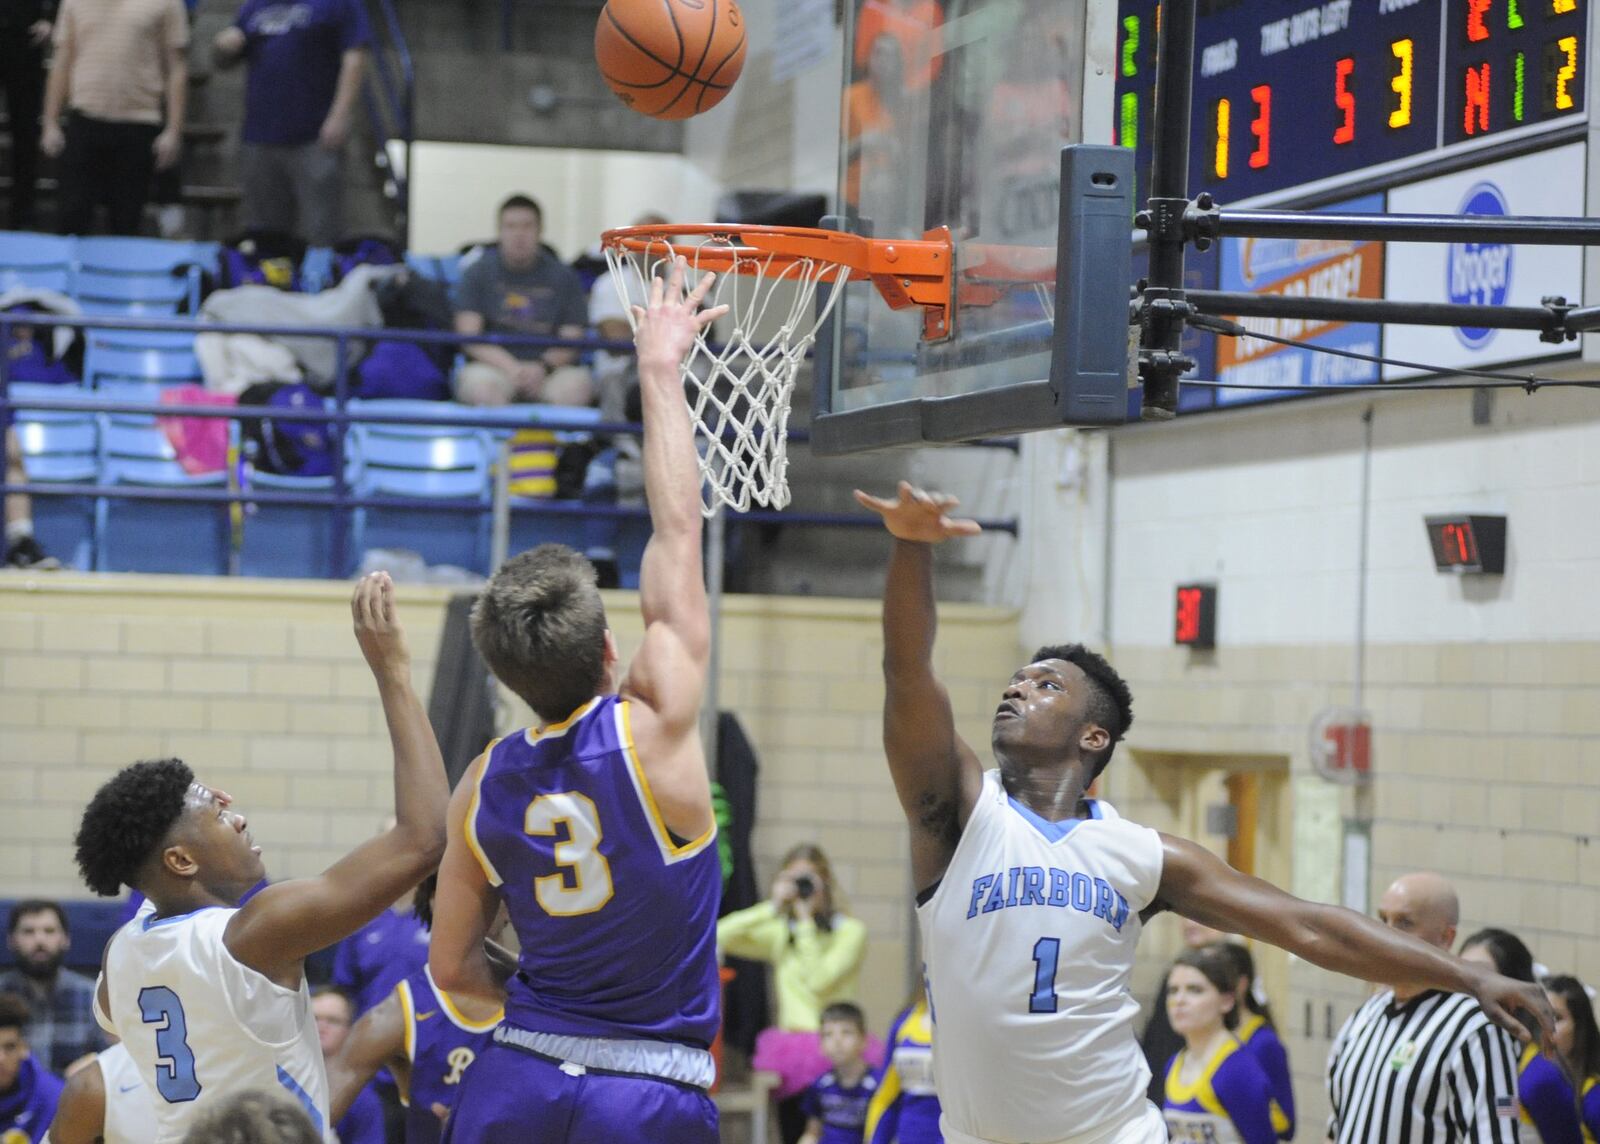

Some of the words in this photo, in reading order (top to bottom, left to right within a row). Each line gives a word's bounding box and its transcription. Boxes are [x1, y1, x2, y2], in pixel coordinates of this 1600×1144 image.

[1333, 57, 1355, 145] 5
[1389, 38, 1413, 129] 3
[1556, 36, 1577, 110] 2
[1249, 84, 1272, 169] 3
[1451, 237, 1509, 306] Kroger
[523, 790, 616, 917] 3
[966, 866, 1131, 933] FAIRBORN
[1028, 936, 1061, 1014] 1
[137, 985, 202, 1104] 3
